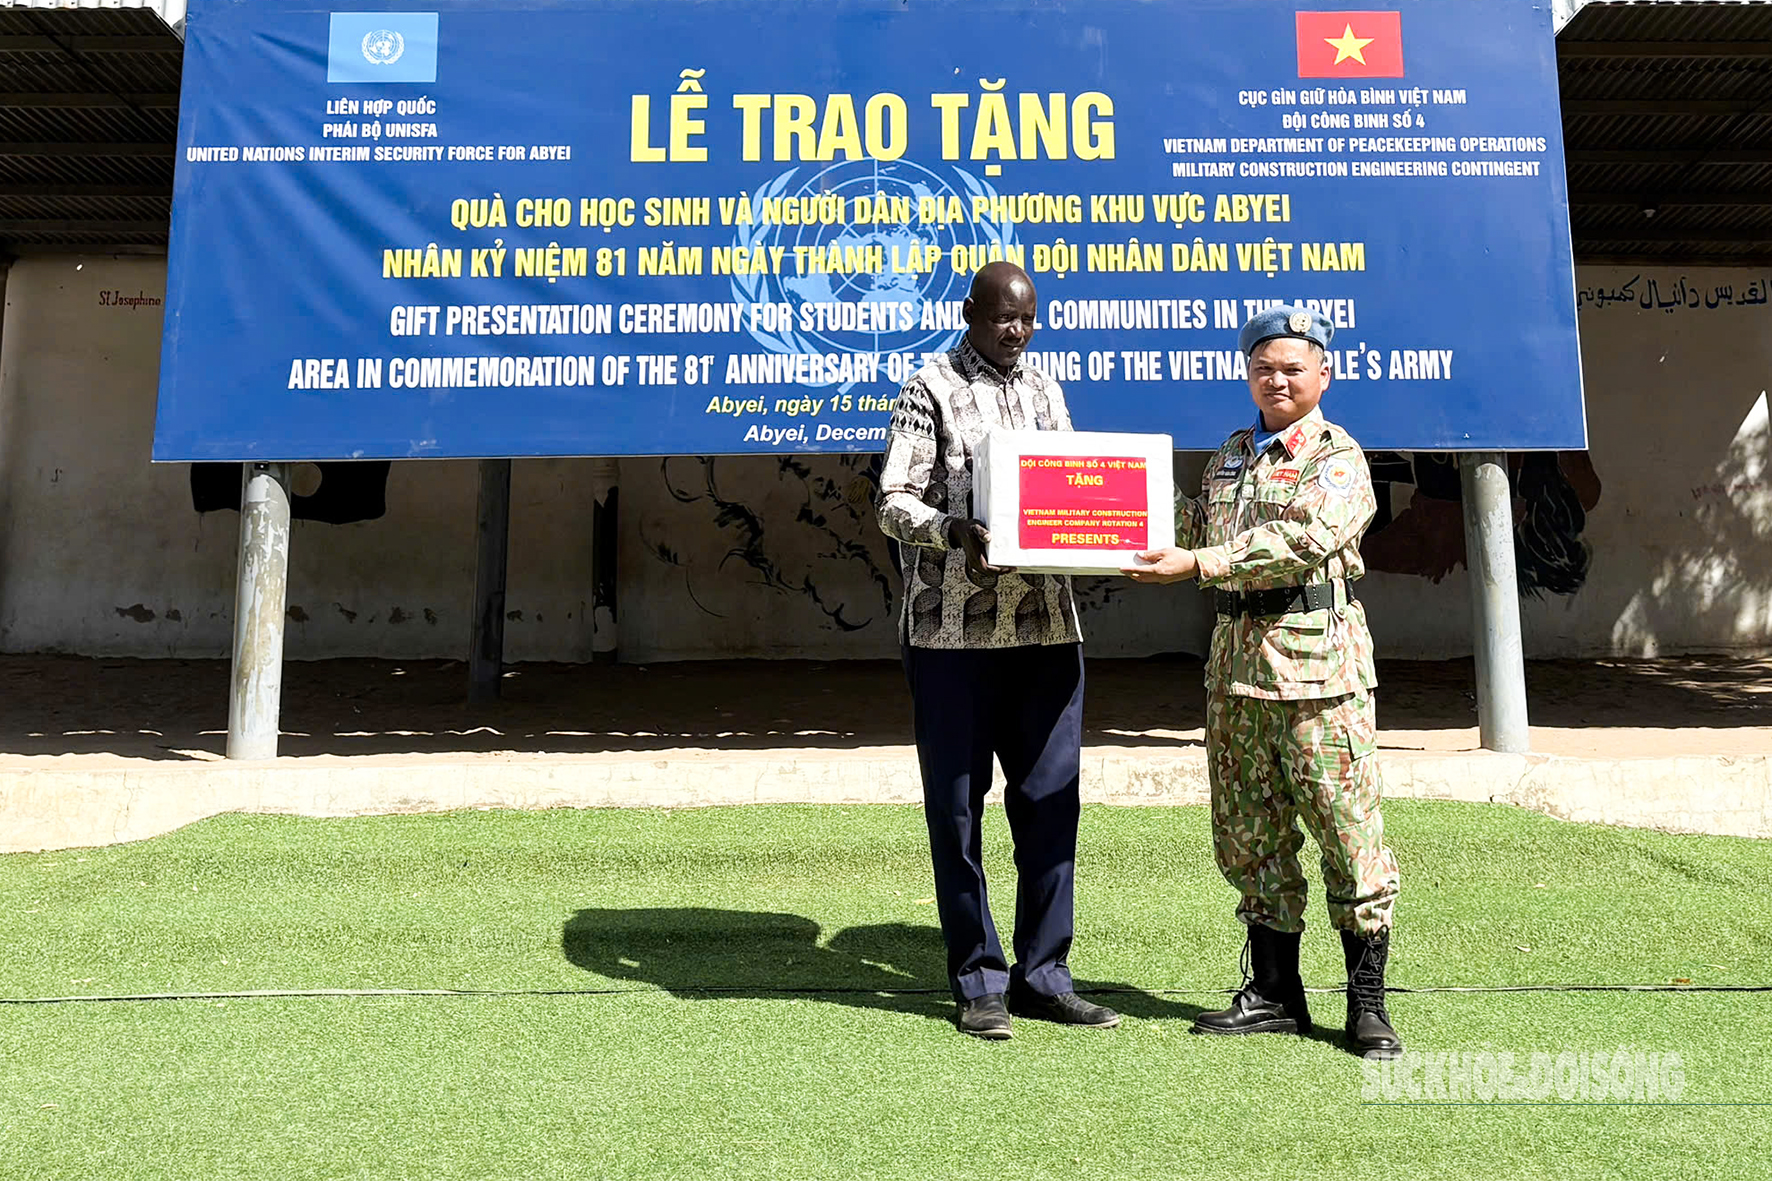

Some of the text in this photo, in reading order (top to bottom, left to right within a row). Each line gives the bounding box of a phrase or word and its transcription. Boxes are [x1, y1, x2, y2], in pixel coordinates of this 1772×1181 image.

[326, 95, 436, 118] LIÊN HỢP QUỐC
[1238, 86, 1467, 107] CỤC GÌN GIỮ HÒA BÌNH VIỆT NAM
[323, 120, 438, 141] PHÁI BỘ UNISFA
[631, 68, 1115, 175] LỄ TRAO TẶNG
[1282, 108, 1426, 132] ĐỘI CÔNG BINH SỐ 4
[186, 145, 571, 162] UNITED NATIONS INTERIM SECURITY FORCE FOR ABYEI
[1163, 137, 1547, 153] VIETNAM DEPARTMENT OF PEACEKEEPING OPERATIONS
[1172, 161, 1541, 178] MILITARY CONSTRUCTION ENGINEERING CONTINGENT
[451, 190, 1291, 233] QUÀ CHO HỌC SINH VÀ NGƯỜI DÂN ĐỊA PHƯƠNG KHU VỰC ABYEI
[382, 237, 1366, 283] NHÂN KỶ NIỆM 81 NĂM NGÀY THÀNH LẬP QUÂN ĐỘI NHÂN DÂN VIỆT NAM
[1704, 279, 1772, 310] لقديس
[390, 305, 441, 336] GIFT
[445, 304, 612, 336] PRESENTATION
[619, 302, 745, 335] CEREMONY
[750, 302, 793, 333] FOR
[799, 301, 914, 333] STUDENTS
[920, 300, 966, 331] AND
[1048, 299, 1207, 330] COMMUNITIES
[1213, 299, 1238, 329] IN
[287, 358, 350, 389] AREA
[356, 358, 382, 388] IN
[389, 355, 595, 389] COMMEMORATION
[602, 355, 630, 386] OF
[636, 355, 678, 385] THE
[725, 352, 881, 385] ANNIVERSARY
[887, 352, 915, 383] OF
[1088, 350, 1115, 381] OF
[1120, 351, 1163, 381] THE
[1168, 350, 1249, 382] VIETNA
[1388, 350, 1453, 380] ARMY
[705, 395, 768, 418] Abyei,
[774, 395, 824, 418] ngày
[830, 393, 852, 413] 15
[743, 424, 887, 447] Abyei, Decem
[1064, 459, 1085, 468] BINH
[1128, 461, 1147, 470] NAM
[1065, 472, 1104, 488] TẶNG
[1057, 509, 1090, 517] MILITARY
[1091, 510, 1148, 518] CONSTRUCTION
[1064, 519, 1100, 527] COMPANY
[1102, 520, 1137, 528] ROTATION
[1051, 532, 1120, 546] PRESENTS
